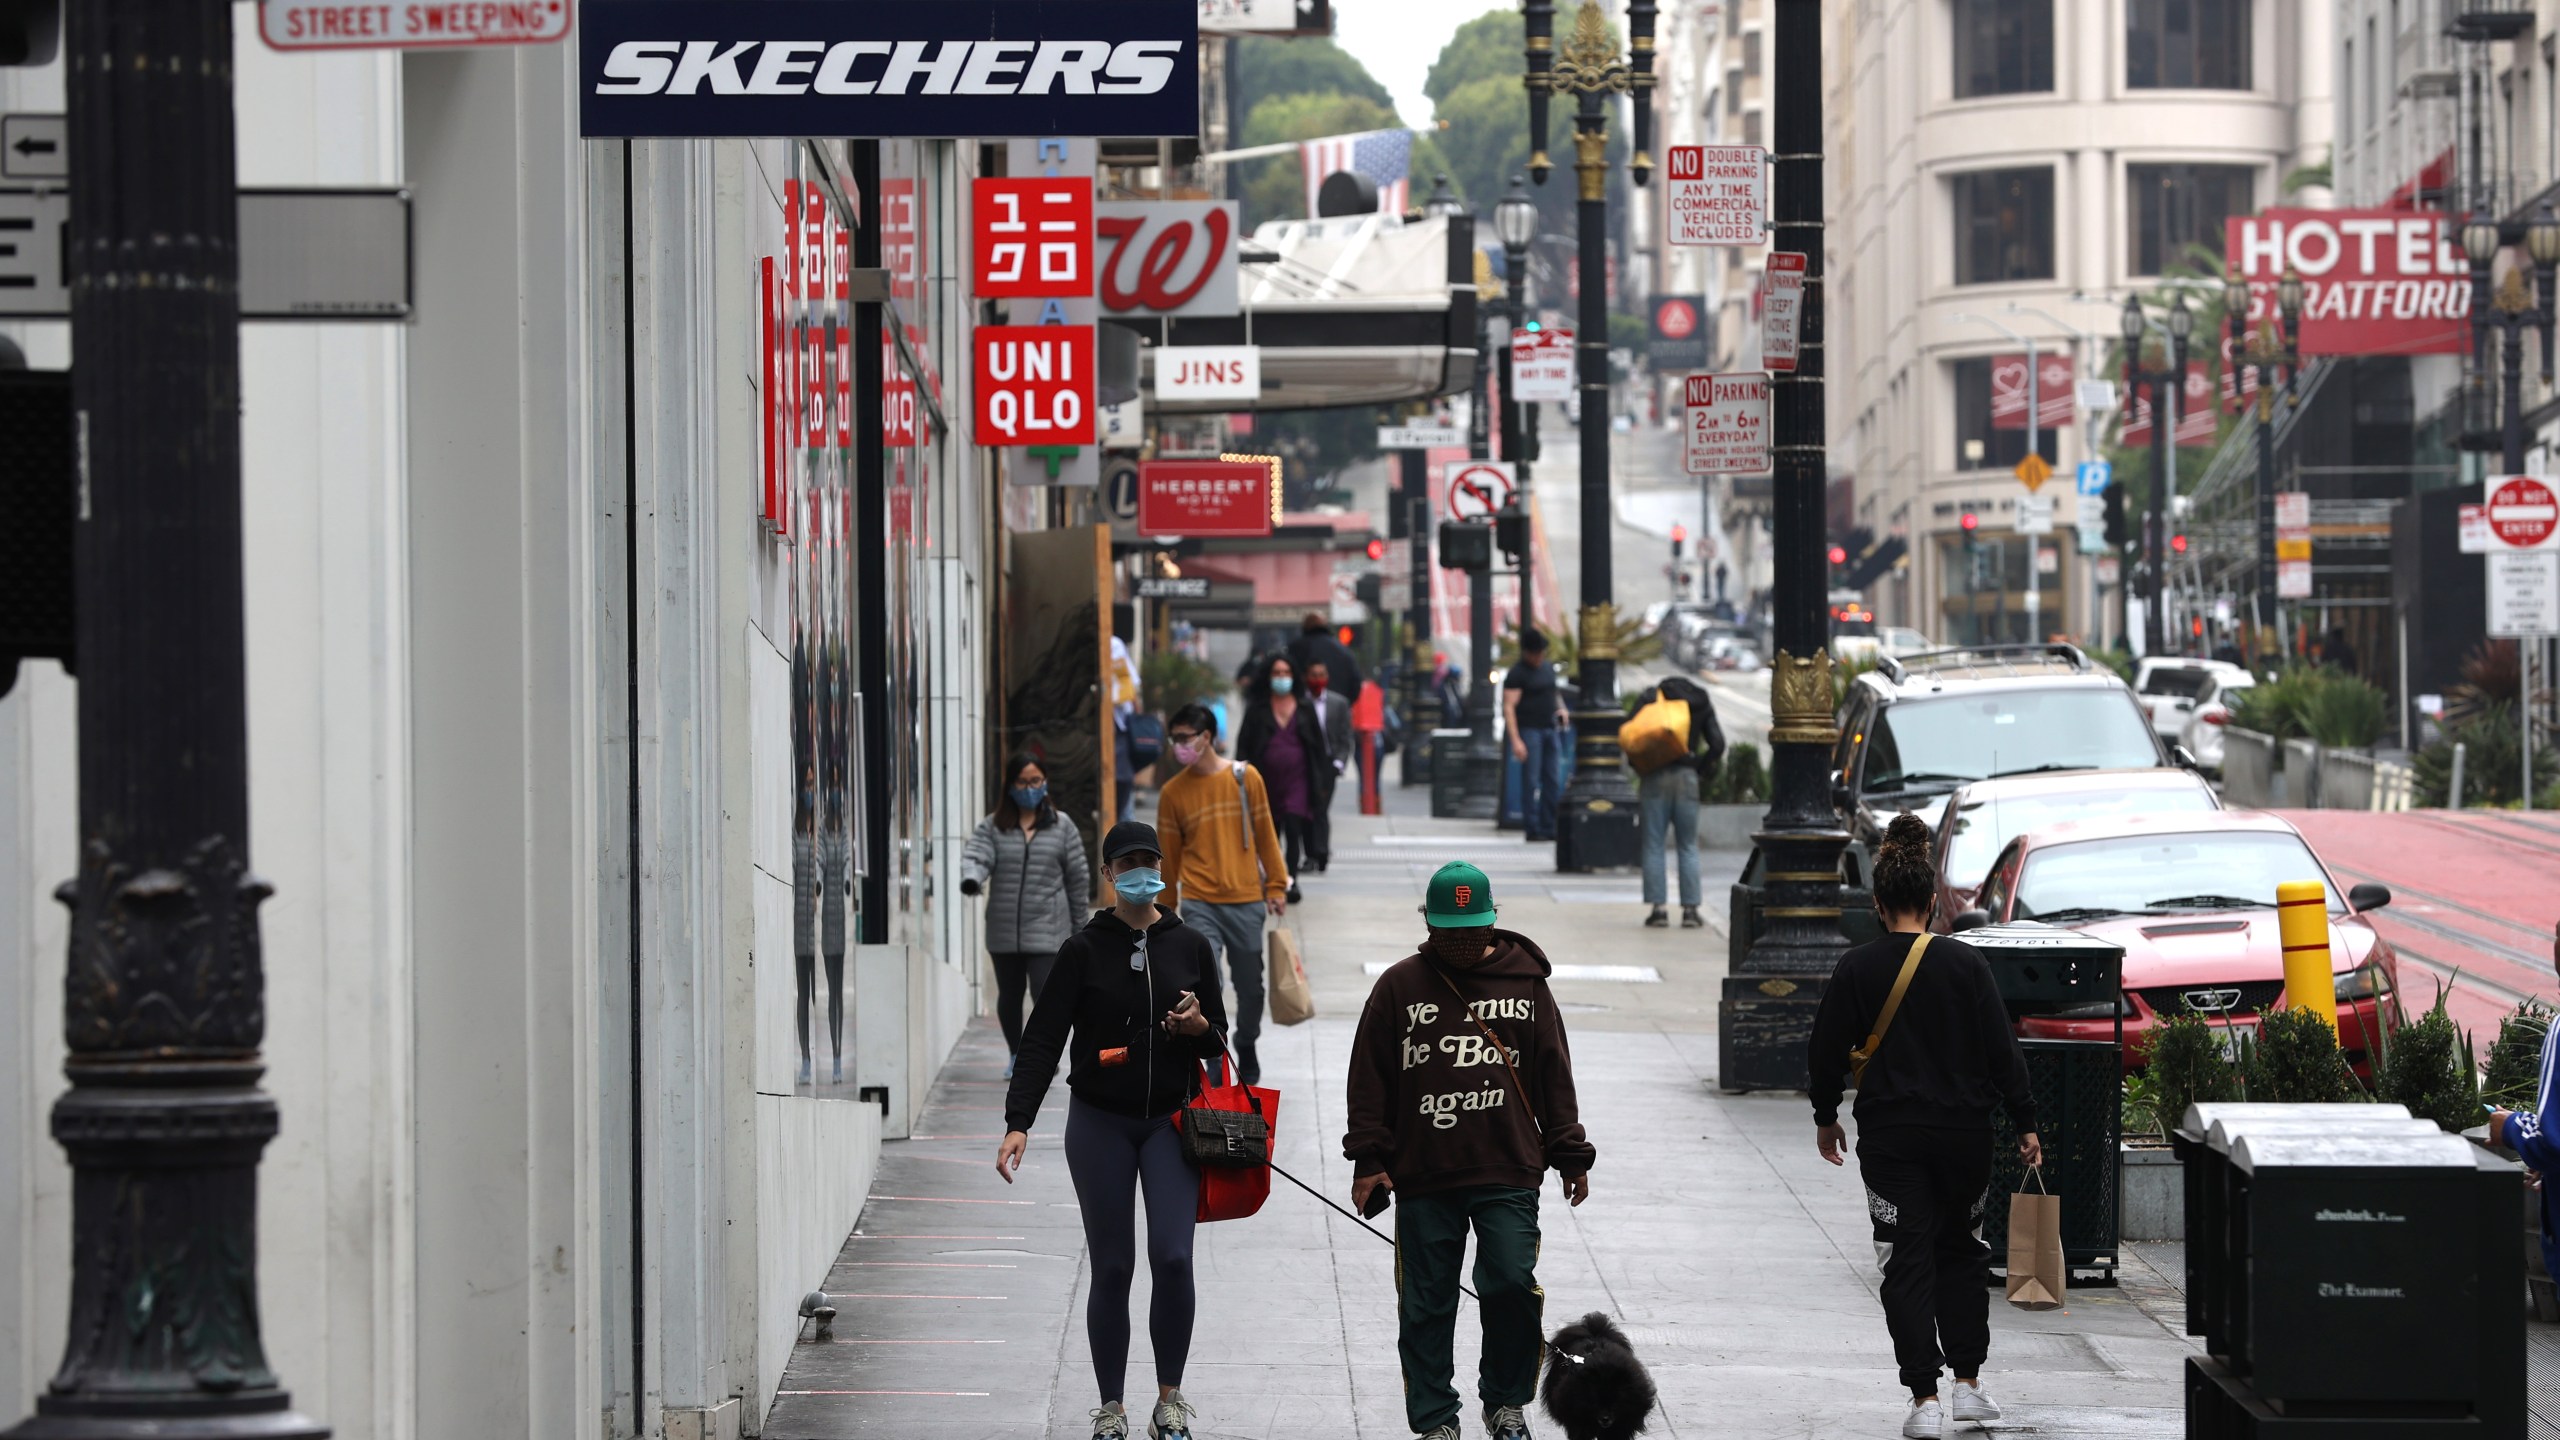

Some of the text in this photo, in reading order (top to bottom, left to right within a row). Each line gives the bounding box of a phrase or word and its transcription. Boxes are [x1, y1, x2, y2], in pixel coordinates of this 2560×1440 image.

[286, 0, 546, 38] STREET SWEEPING
[596, 40, 1183, 95] SKECHERS
[1671, 149, 1699, 176] NO
[1708, 150, 1758, 163] DOUBLE
[1708, 165, 1758, 179] PARKING
[1683, 183, 1752, 196] ANY TIME
[1673, 197, 1761, 211] COMMERCIAL
[1683, 212, 1754, 225] VEHICLES
[1681, 226, 1754, 239] INCLUDED
[2241, 218, 2470, 277] HOTEL
[988, 340, 1072, 382] UNI
[1544, 366, 1567, 380] TIME
[1688, 378, 1768, 405] NO PARKING
[989, 389, 1081, 438] QLO
[1698, 430, 1757, 444] EVERYDAY
[1690, 445, 1766, 457] INCLUDING HOLIDAYS
[1694, 456, 1763, 470] STREET SWEEPING
[1151, 479, 1256, 495] HERBERT
[1176, 495, 1232, 506] HOTEL
[2497, 490, 2549, 504] DO NOT
[2502, 522, 2545, 536] ENTER
[1406, 1002, 1440, 1033] ye
[1401, 1036, 1431, 1071] be
[1419, 1079, 1505, 1130] again
